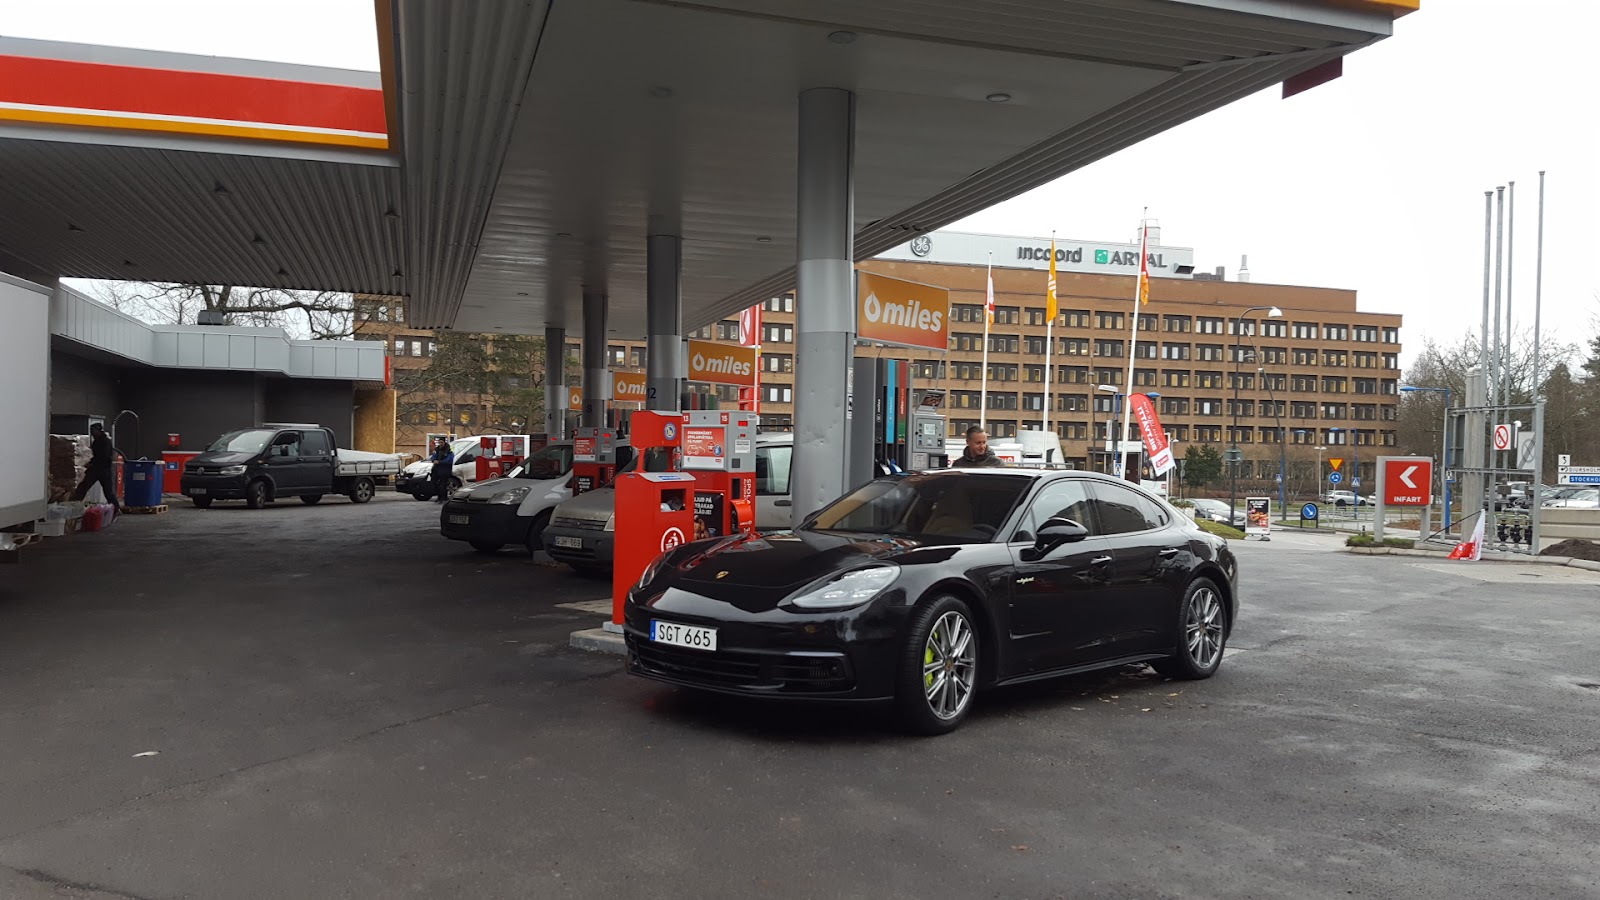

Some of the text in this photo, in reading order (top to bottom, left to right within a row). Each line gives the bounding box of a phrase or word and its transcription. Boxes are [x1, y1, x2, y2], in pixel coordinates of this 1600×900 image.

[882, 299, 943, 332] miles
[705, 355, 751, 376] miles
[659, 624, 711, 647] SGT 665
